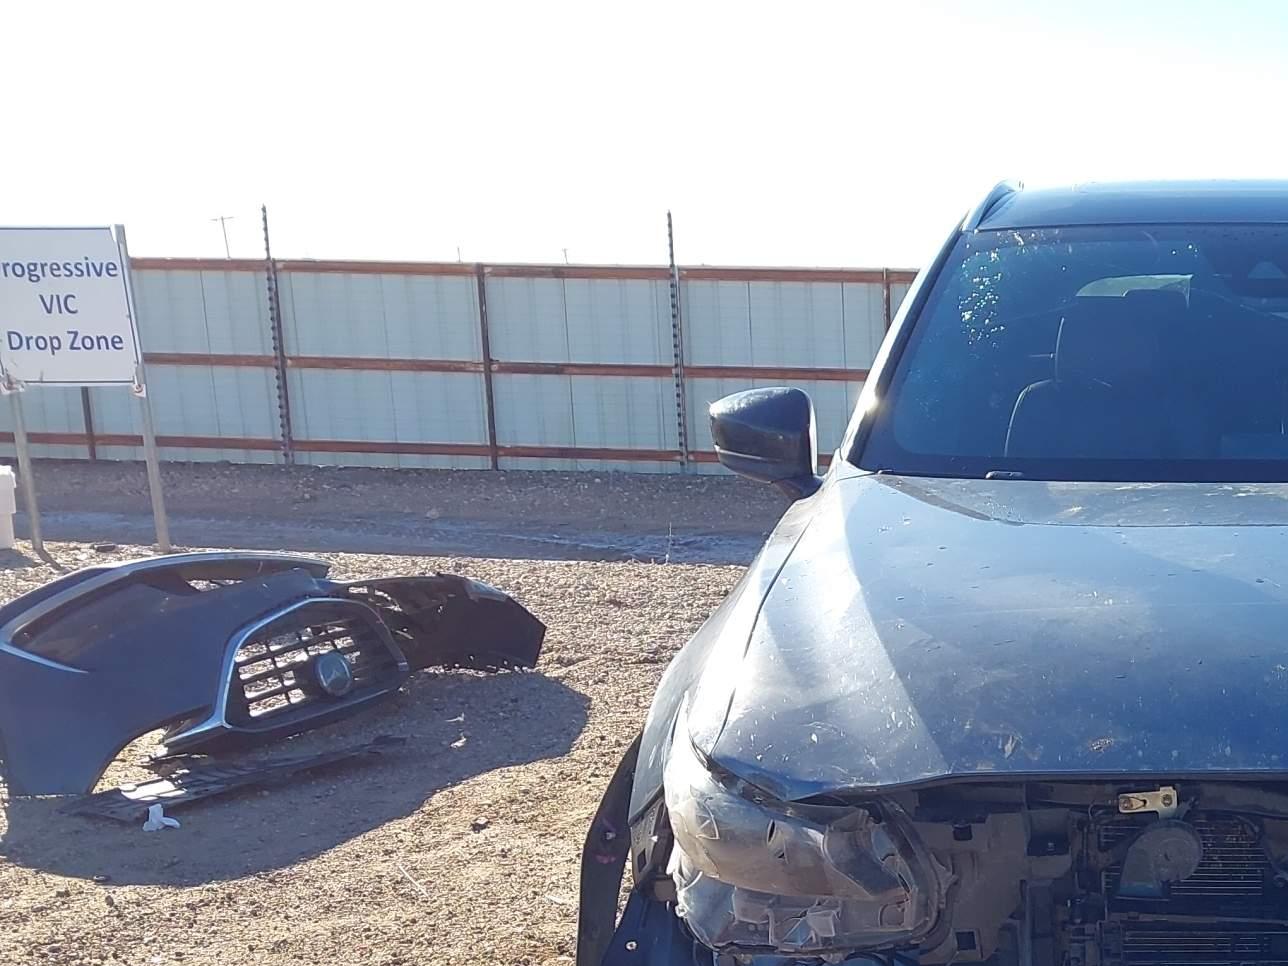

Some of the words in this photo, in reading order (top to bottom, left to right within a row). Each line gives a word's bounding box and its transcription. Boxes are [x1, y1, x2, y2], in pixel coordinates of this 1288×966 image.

[1, 257, 118, 283] rogressive
[39, 294, 78, 314] VIC
[7, 331, 62, 356] Drop
[66, 330, 124, 350] Zone
